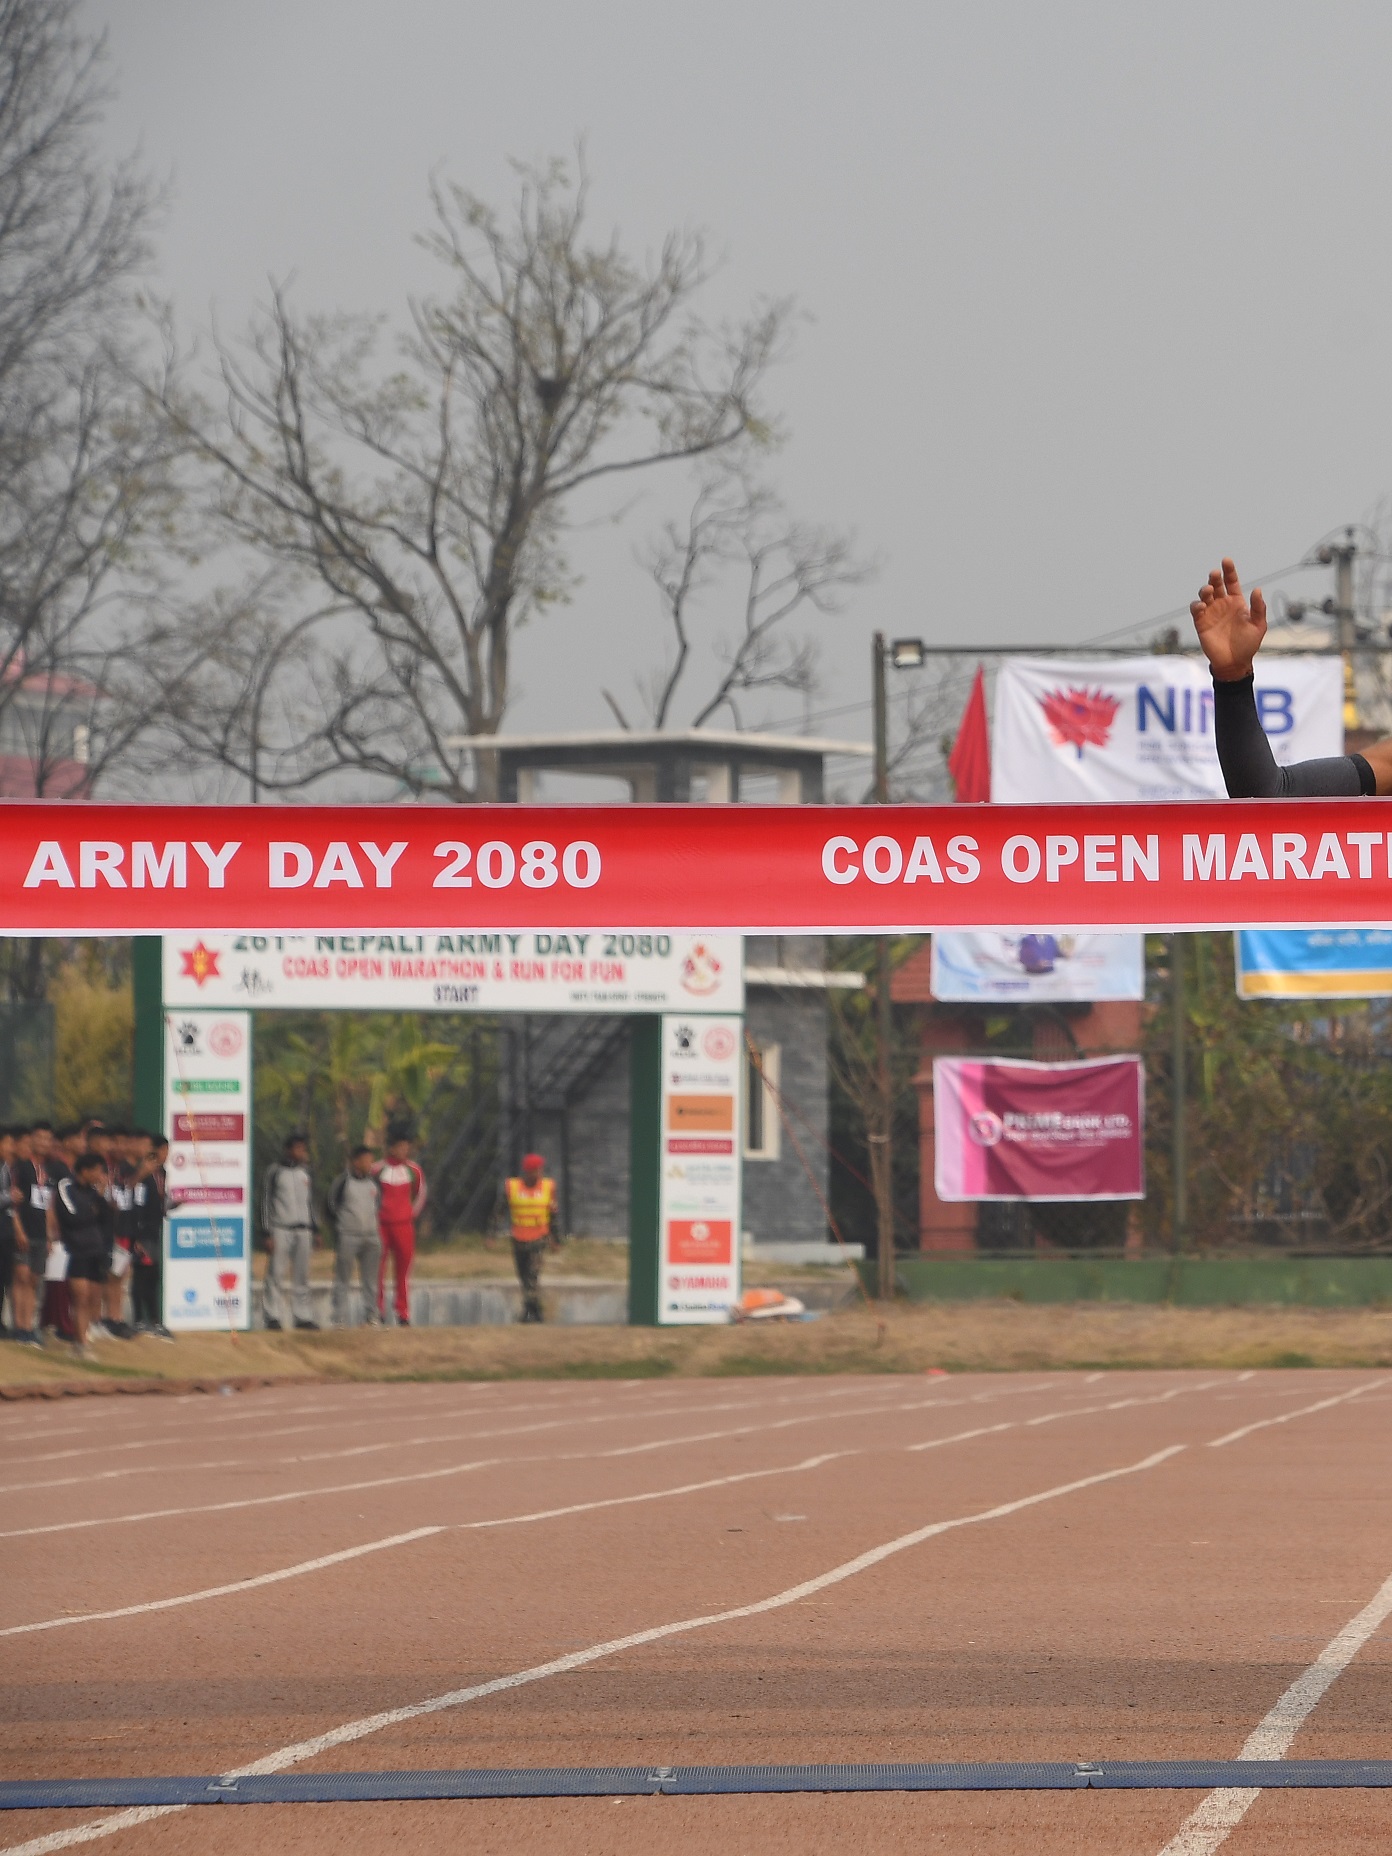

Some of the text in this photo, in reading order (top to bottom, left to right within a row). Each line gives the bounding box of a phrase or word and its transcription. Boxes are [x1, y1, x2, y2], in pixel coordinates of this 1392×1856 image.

[1137, 685, 1294, 734] NIB
[22, 840, 602, 889] ARMY DAY 2080
[821, 835, 981, 885] COAS
[1001, 833, 1160, 883] OPEN
[233, 934, 671, 957] 261 NEPALI ARMY DAY 2080
[283, 957, 331, 979] COAS
[336, 957, 383, 980] OPEN
[389, 958, 485, 981] MARATHON
[510, 960, 546, 981] RUN
[551, 960, 585, 981] FOR
[590, 960, 625, 982] FUN
[434, 985, 478, 1002] START
